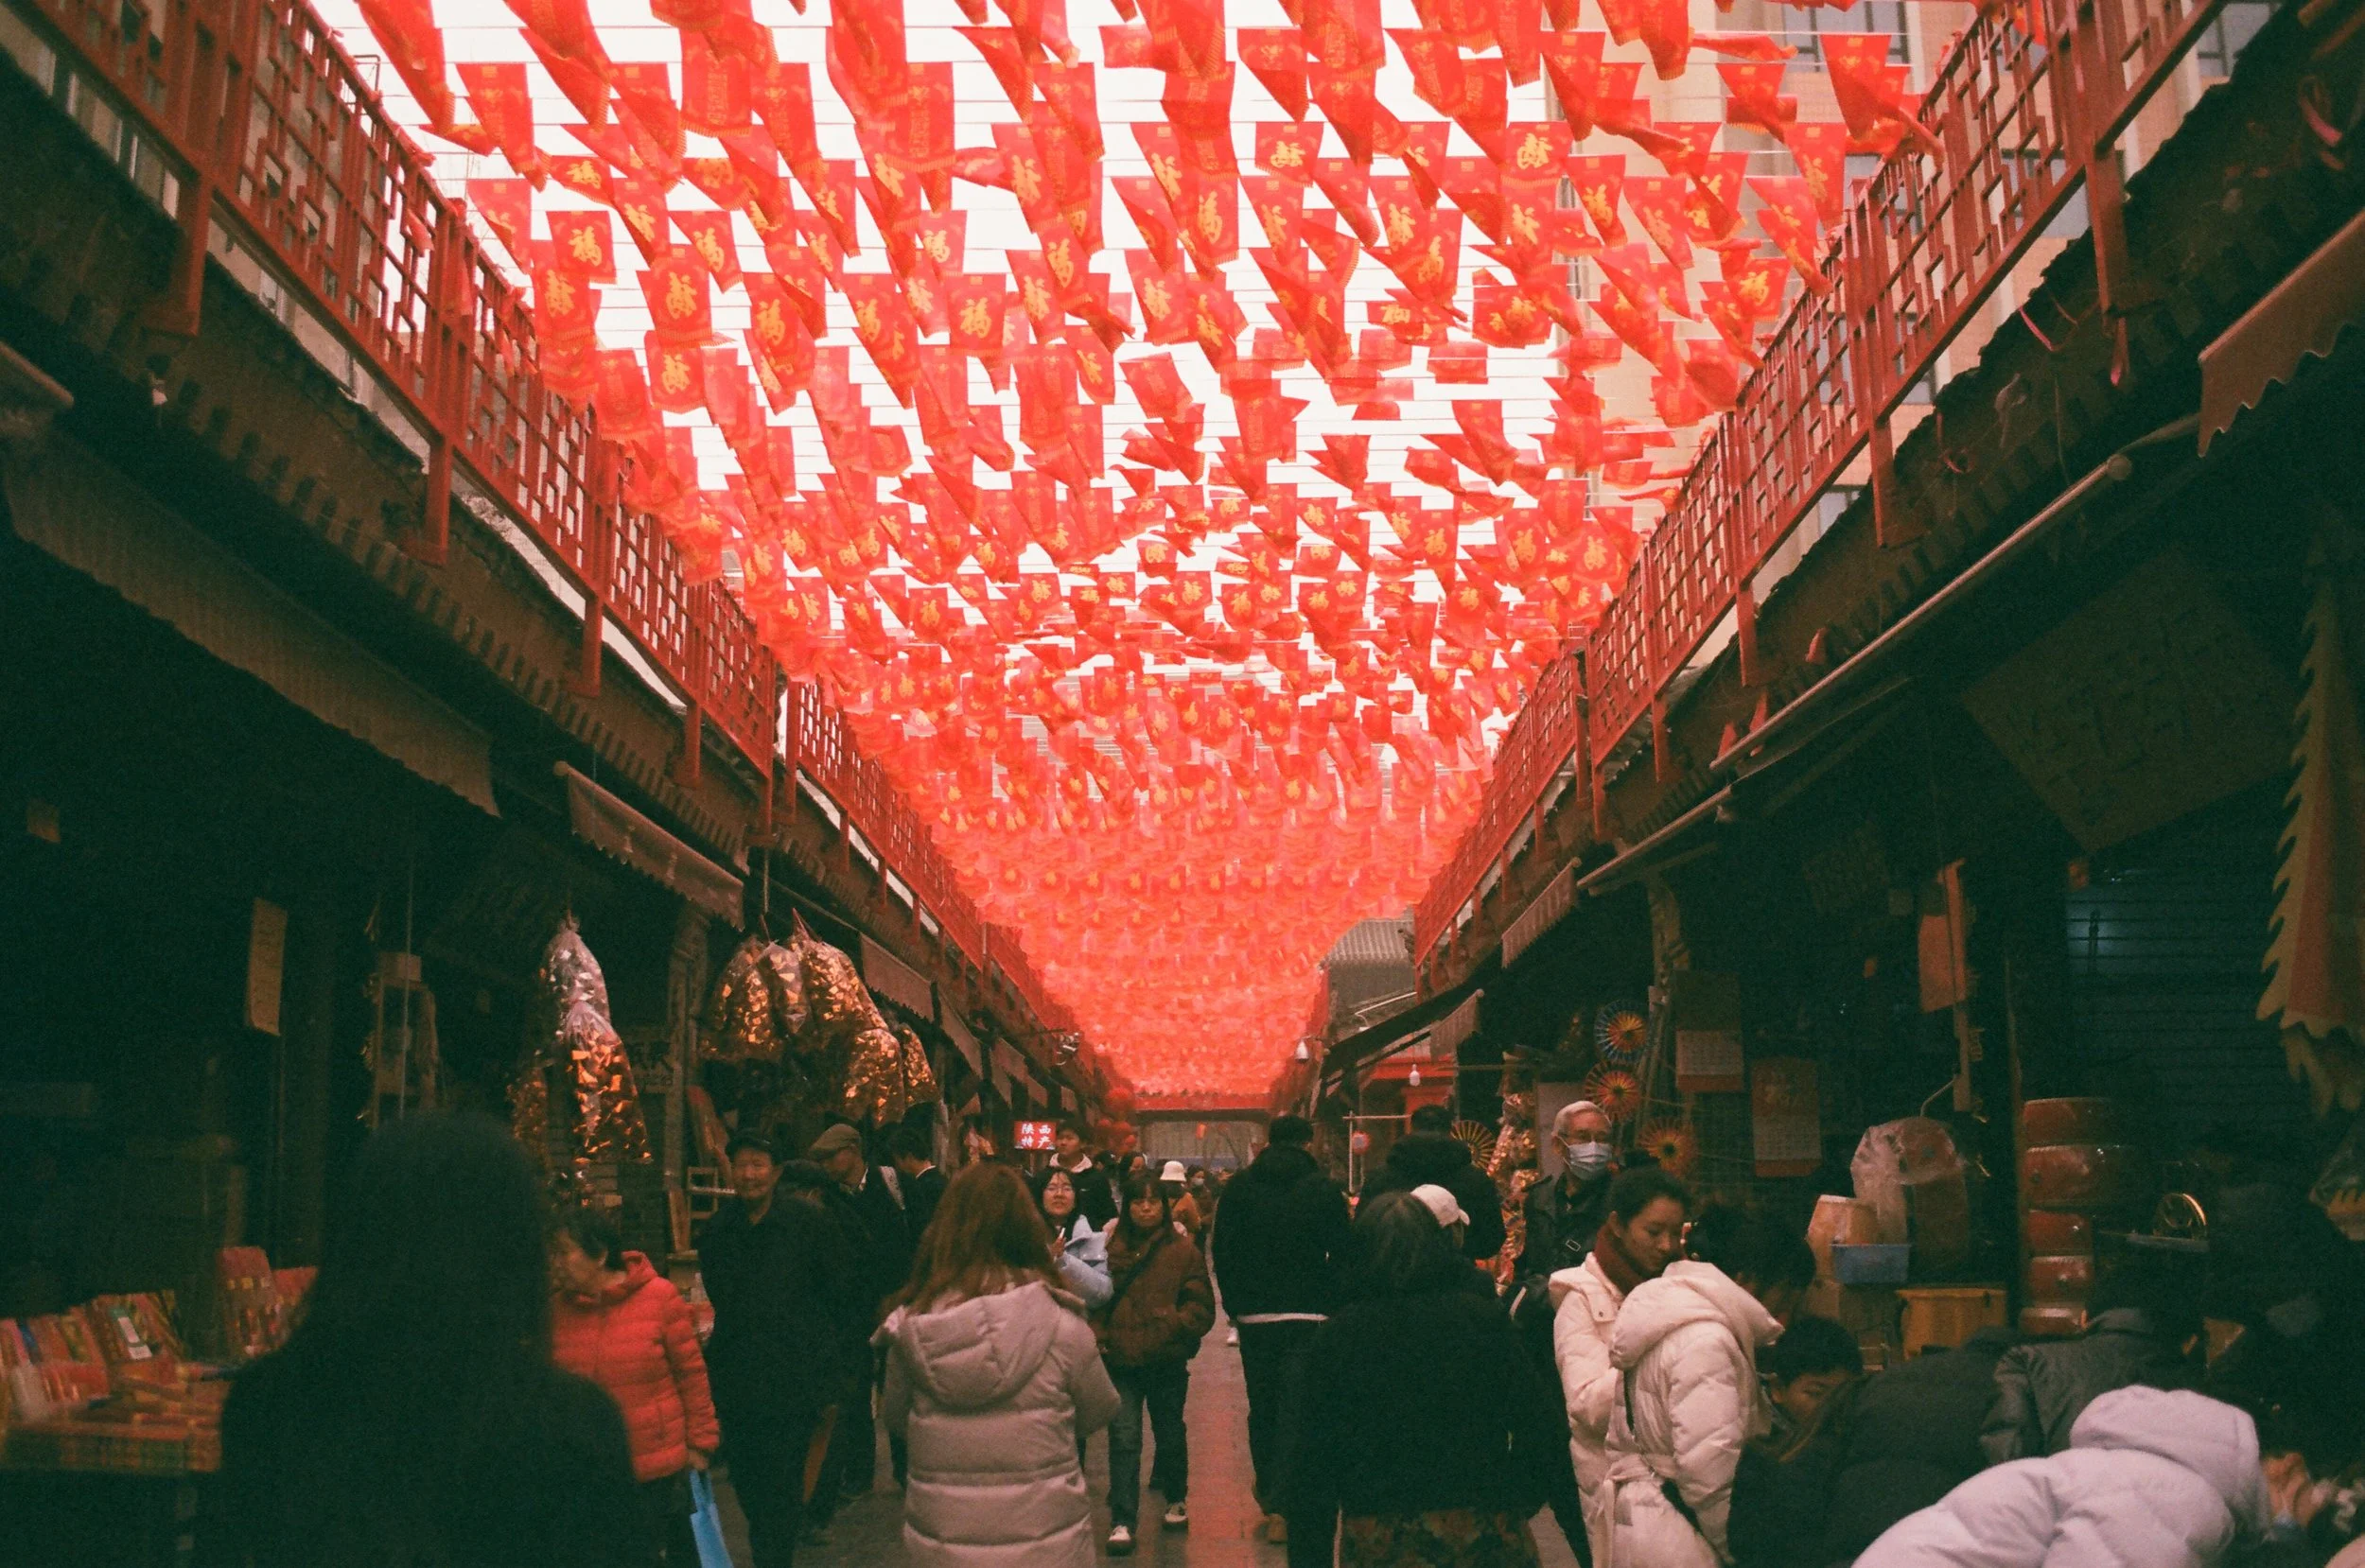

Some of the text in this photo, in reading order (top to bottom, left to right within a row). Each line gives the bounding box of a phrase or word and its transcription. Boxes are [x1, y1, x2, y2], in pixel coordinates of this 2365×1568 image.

[569, 225, 603, 267] 福
[960, 296, 992, 340] 福
[1021, 1137, 1051, 1148] 特产
[1022, 1124, 1051, 1135] 陕西
